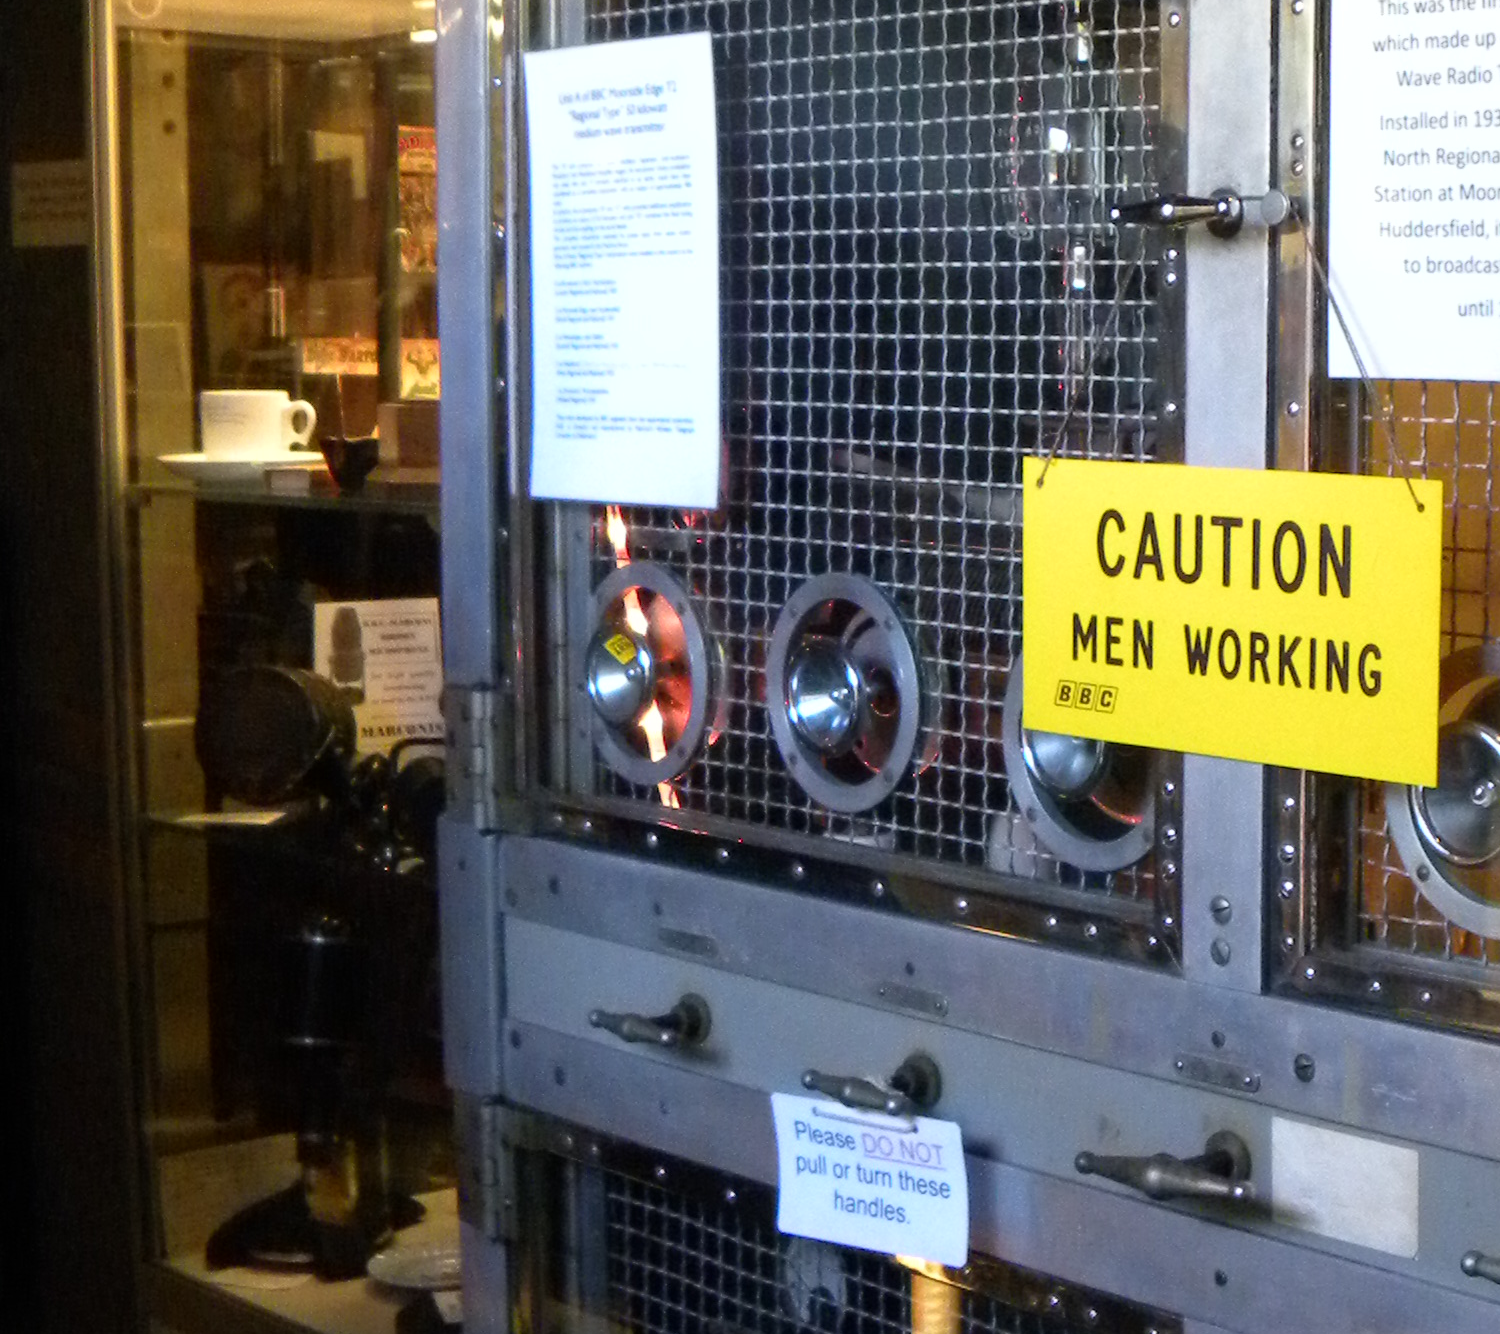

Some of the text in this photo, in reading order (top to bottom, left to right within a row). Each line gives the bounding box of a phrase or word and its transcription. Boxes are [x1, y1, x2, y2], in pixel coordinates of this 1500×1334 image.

[1413, 0, 1445, 14] was
[1373, 34, 1420, 53] which
[1424, 30, 1470, 49] made
[1474, 33, 1495, 52] up
[1396, 68, 1441, 87] Wave
[1447, 66, 1493, 85] Radio
[1379, 112, 1449, 132] Installed
[1454, 112, 1468, 129] in
[1384, 148, 1430, 166] North
[1374, 184, 1433, 203] Station
[1438, 186, 1454, 201] at
[1379, 219, 1490, 241] Huddersfield,
[1404, 257, 1422, 274] to
[1457, 300, 1494, 317] until
[1097, 509, 1352, 598] CAUTION
[1072, 613, 1382, 697] MEN WORKING
[1056, 682, 1116, 712] BBC
[794, 1120, 944, 1165] Please DO NOT
[796, 1155, 951, 1199] pull or turn these
[834, 1190, 911, 1225] handles.
